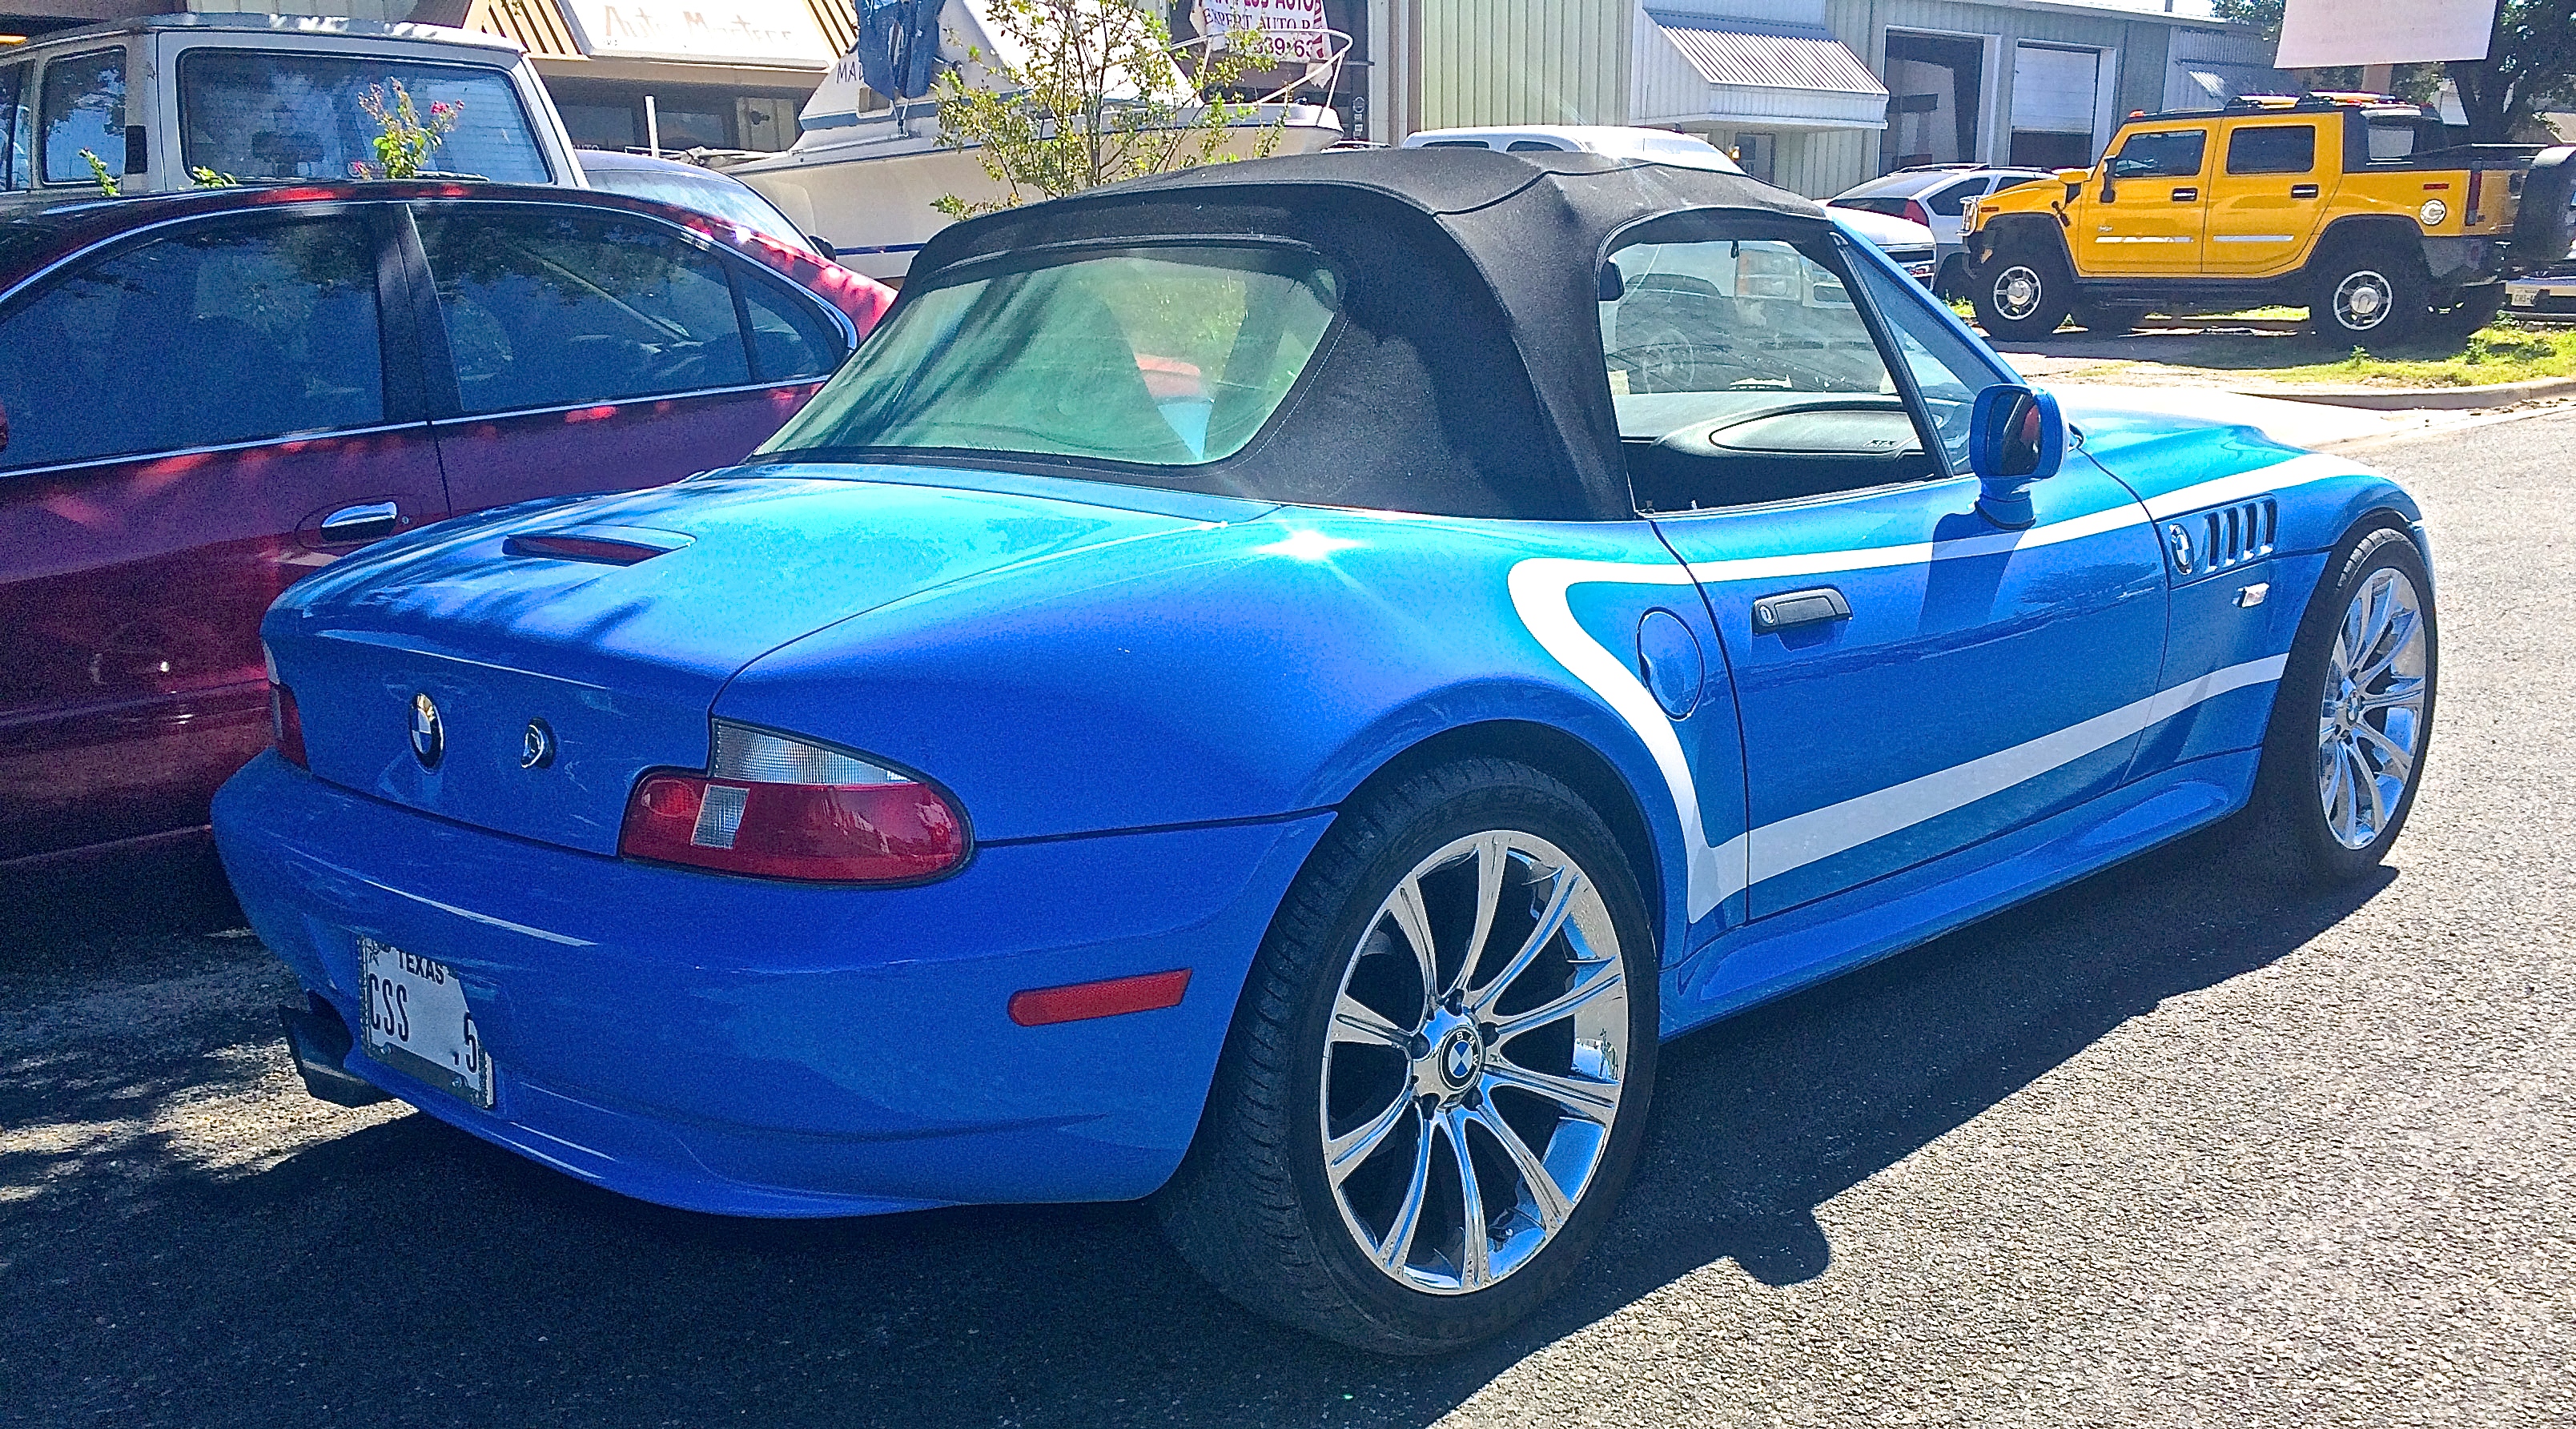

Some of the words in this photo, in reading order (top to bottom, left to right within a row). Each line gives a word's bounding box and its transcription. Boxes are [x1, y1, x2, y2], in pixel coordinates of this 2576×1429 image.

[1203, 8, 1252, 30] EXPERT
[1259, 16, 1296, 30] AUTO
[399, 949, 445, 985] TEXAS
[368, 973, 409, 1042] CSS
[1456, 1031, 1480, 1066] BMW
